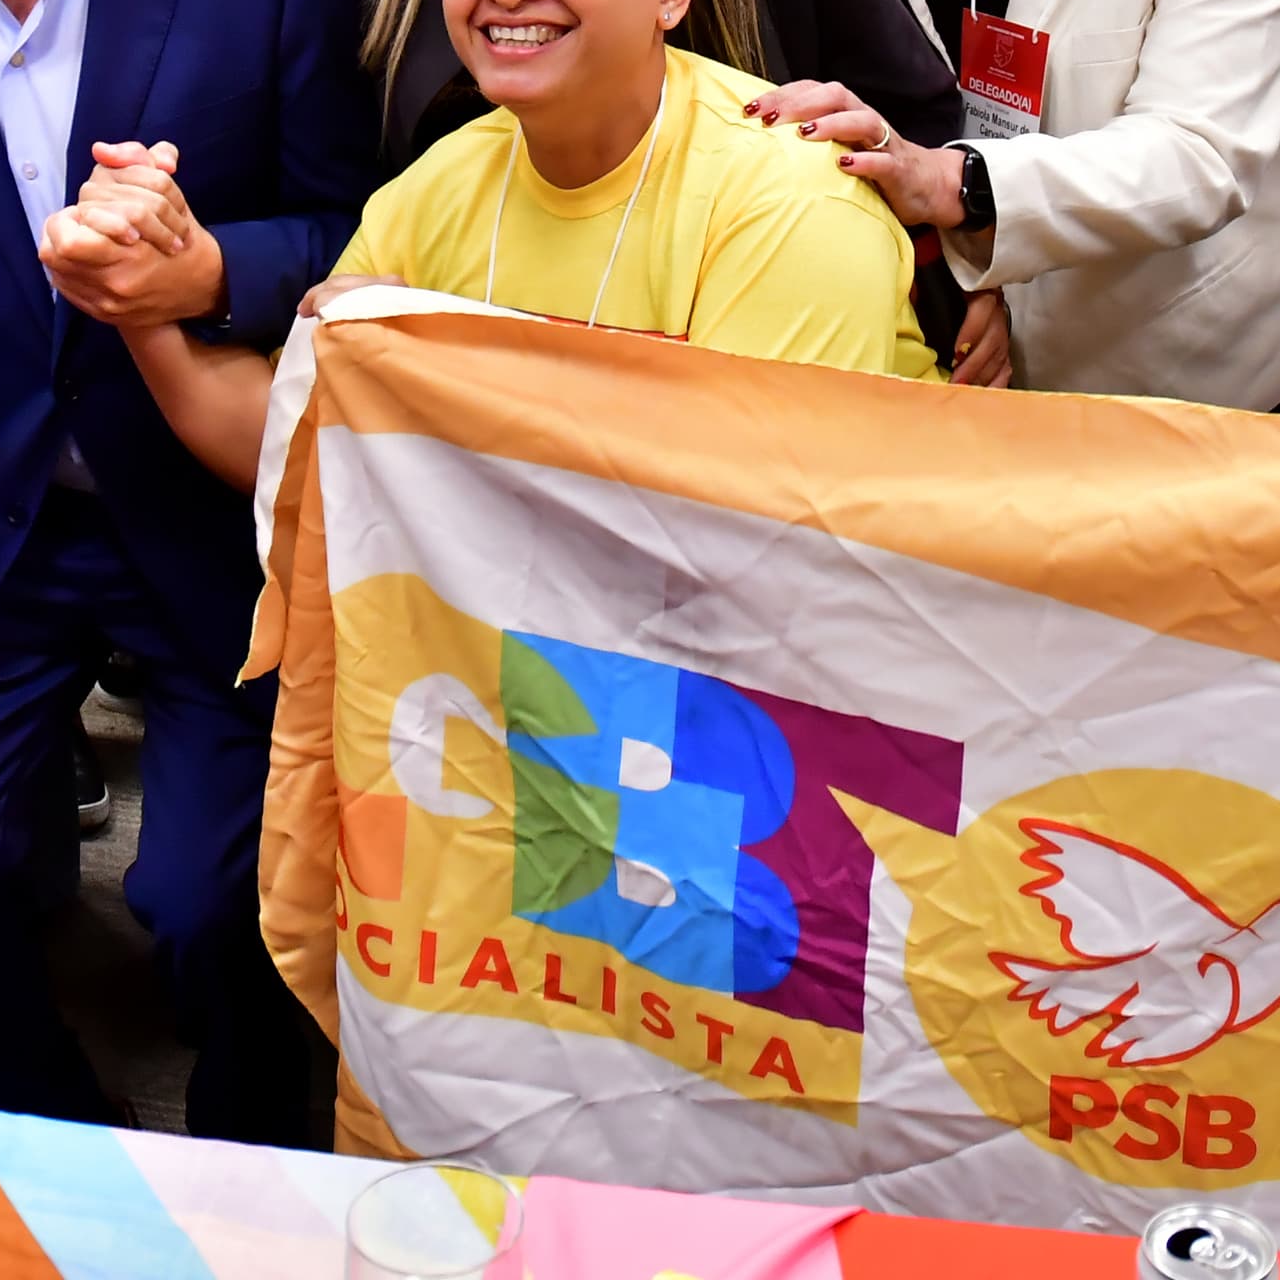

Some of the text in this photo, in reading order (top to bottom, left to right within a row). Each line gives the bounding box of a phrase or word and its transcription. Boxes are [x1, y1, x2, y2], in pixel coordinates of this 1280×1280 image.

[964, 101, 990, 122] Fabiola
[991, 112, 1019, 132] Mansur
[968, 77, 1032, 113] DELEGADO(A)
[336, 878, 806, 1095] CIALISTA
[1048, 1074, 1258, 1170] PSB
